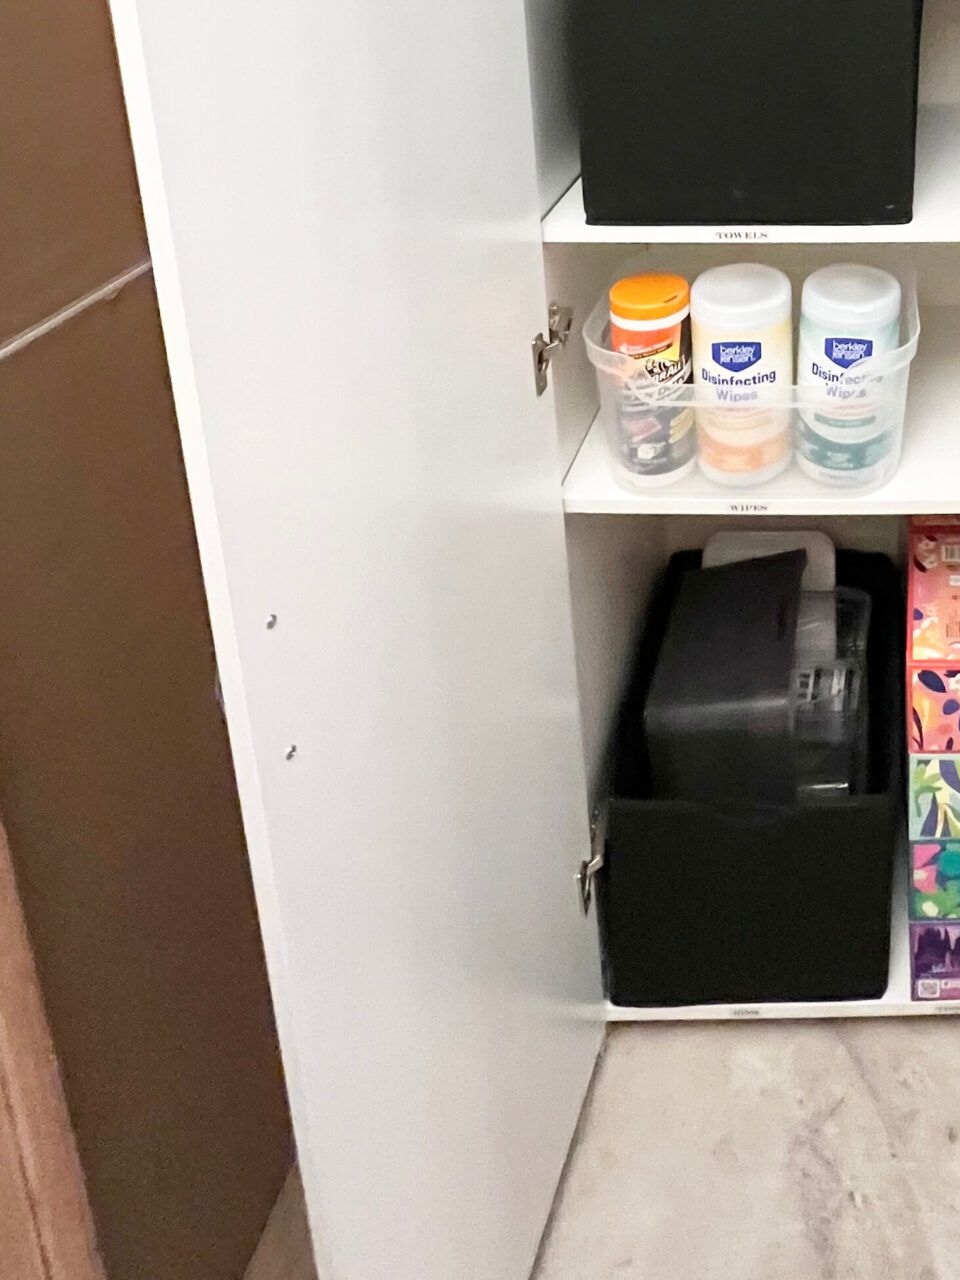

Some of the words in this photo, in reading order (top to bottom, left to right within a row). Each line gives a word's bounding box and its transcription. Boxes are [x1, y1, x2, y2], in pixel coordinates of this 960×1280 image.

[715, 231, 768, 239] TOWELS
[701, 367, 776, 386] Disinfecting
[716, 387, 758, 402] Wipes
[730, 504, 768, 512] WIPES
